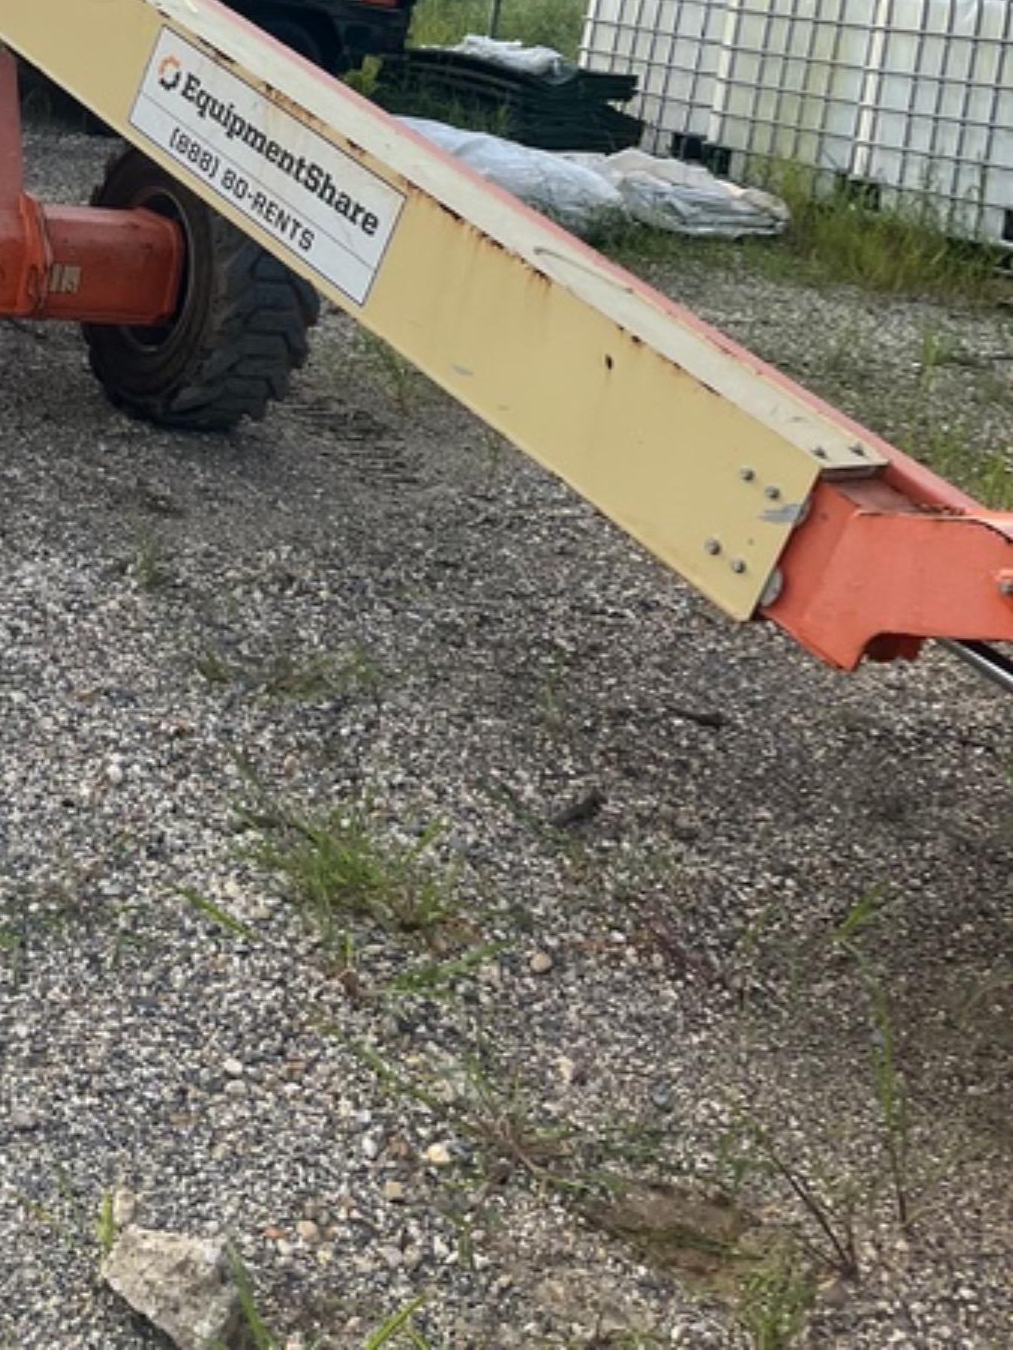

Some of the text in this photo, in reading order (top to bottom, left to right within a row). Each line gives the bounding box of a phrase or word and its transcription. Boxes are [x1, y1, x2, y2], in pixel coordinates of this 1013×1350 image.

[168, 126, 316, 252] (888) 80-RENTS
[181, 72, 379, 236] EquipmentShare
